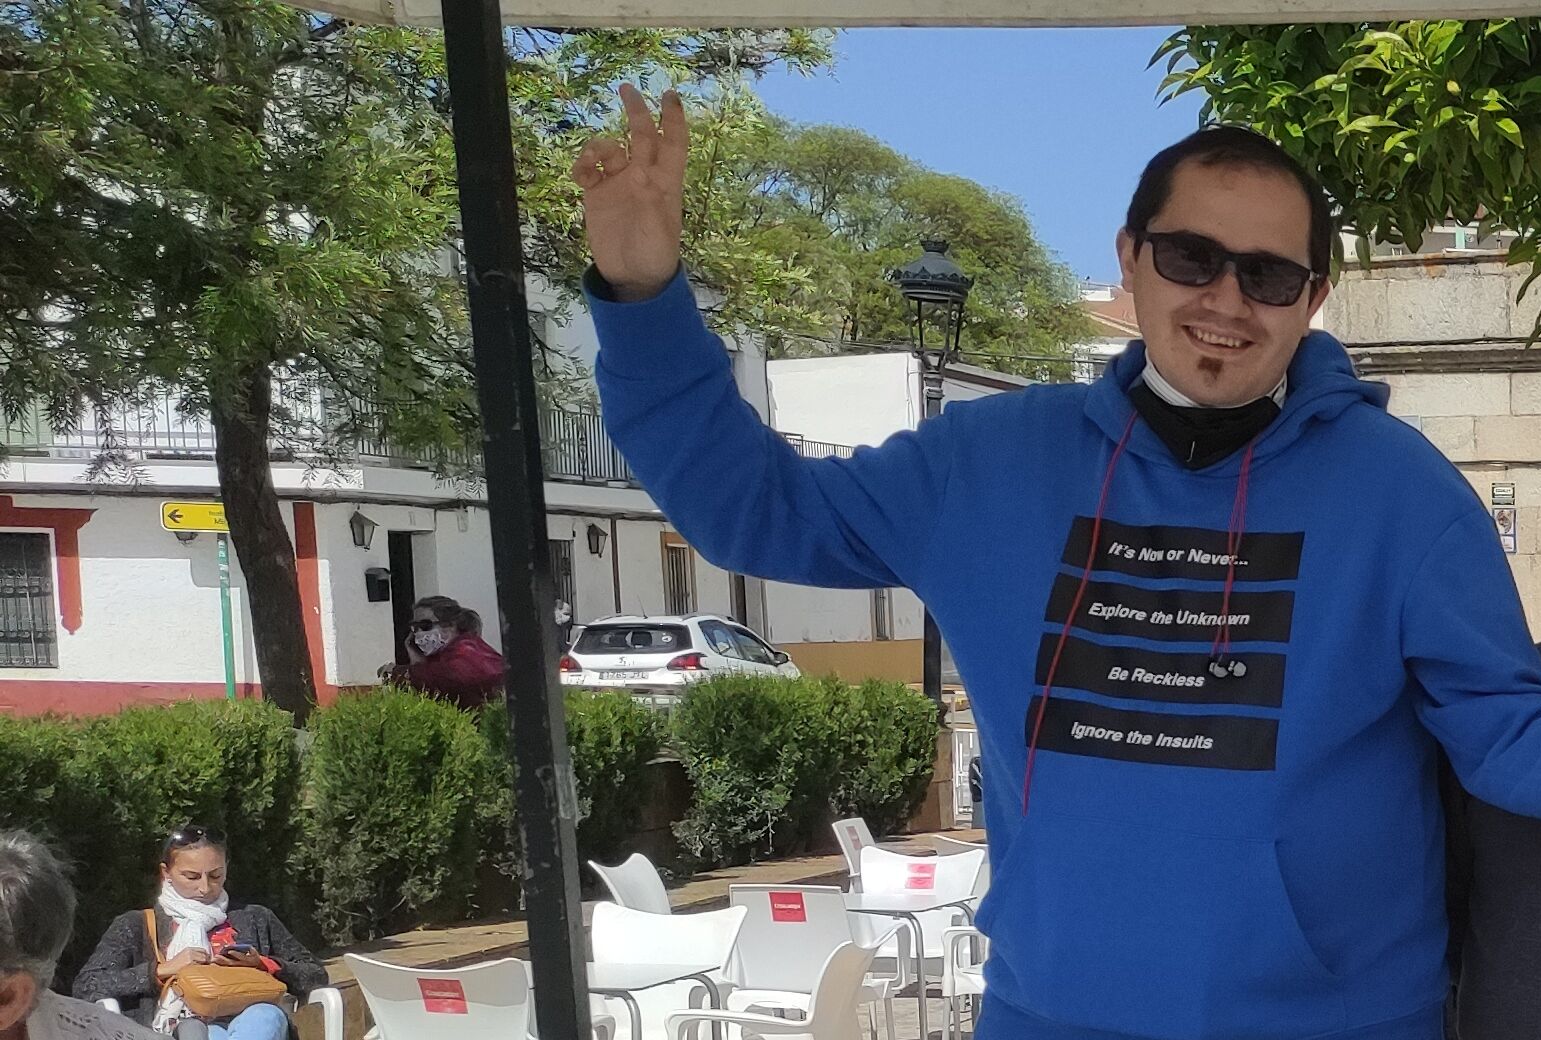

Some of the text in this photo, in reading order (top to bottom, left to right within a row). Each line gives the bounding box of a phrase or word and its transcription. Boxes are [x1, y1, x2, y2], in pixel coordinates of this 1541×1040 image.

[1108, 542, 1135, 559] It's
[1138, 548, 1163, 561] Now
[1167, 549, 1184, 561] or
[1089, 603, 1250, 626] Explore the Unknown
[1107, 667, 1204, 688] Be Reckless
[1071, 722, 1213, 750] Ignore the Insults
